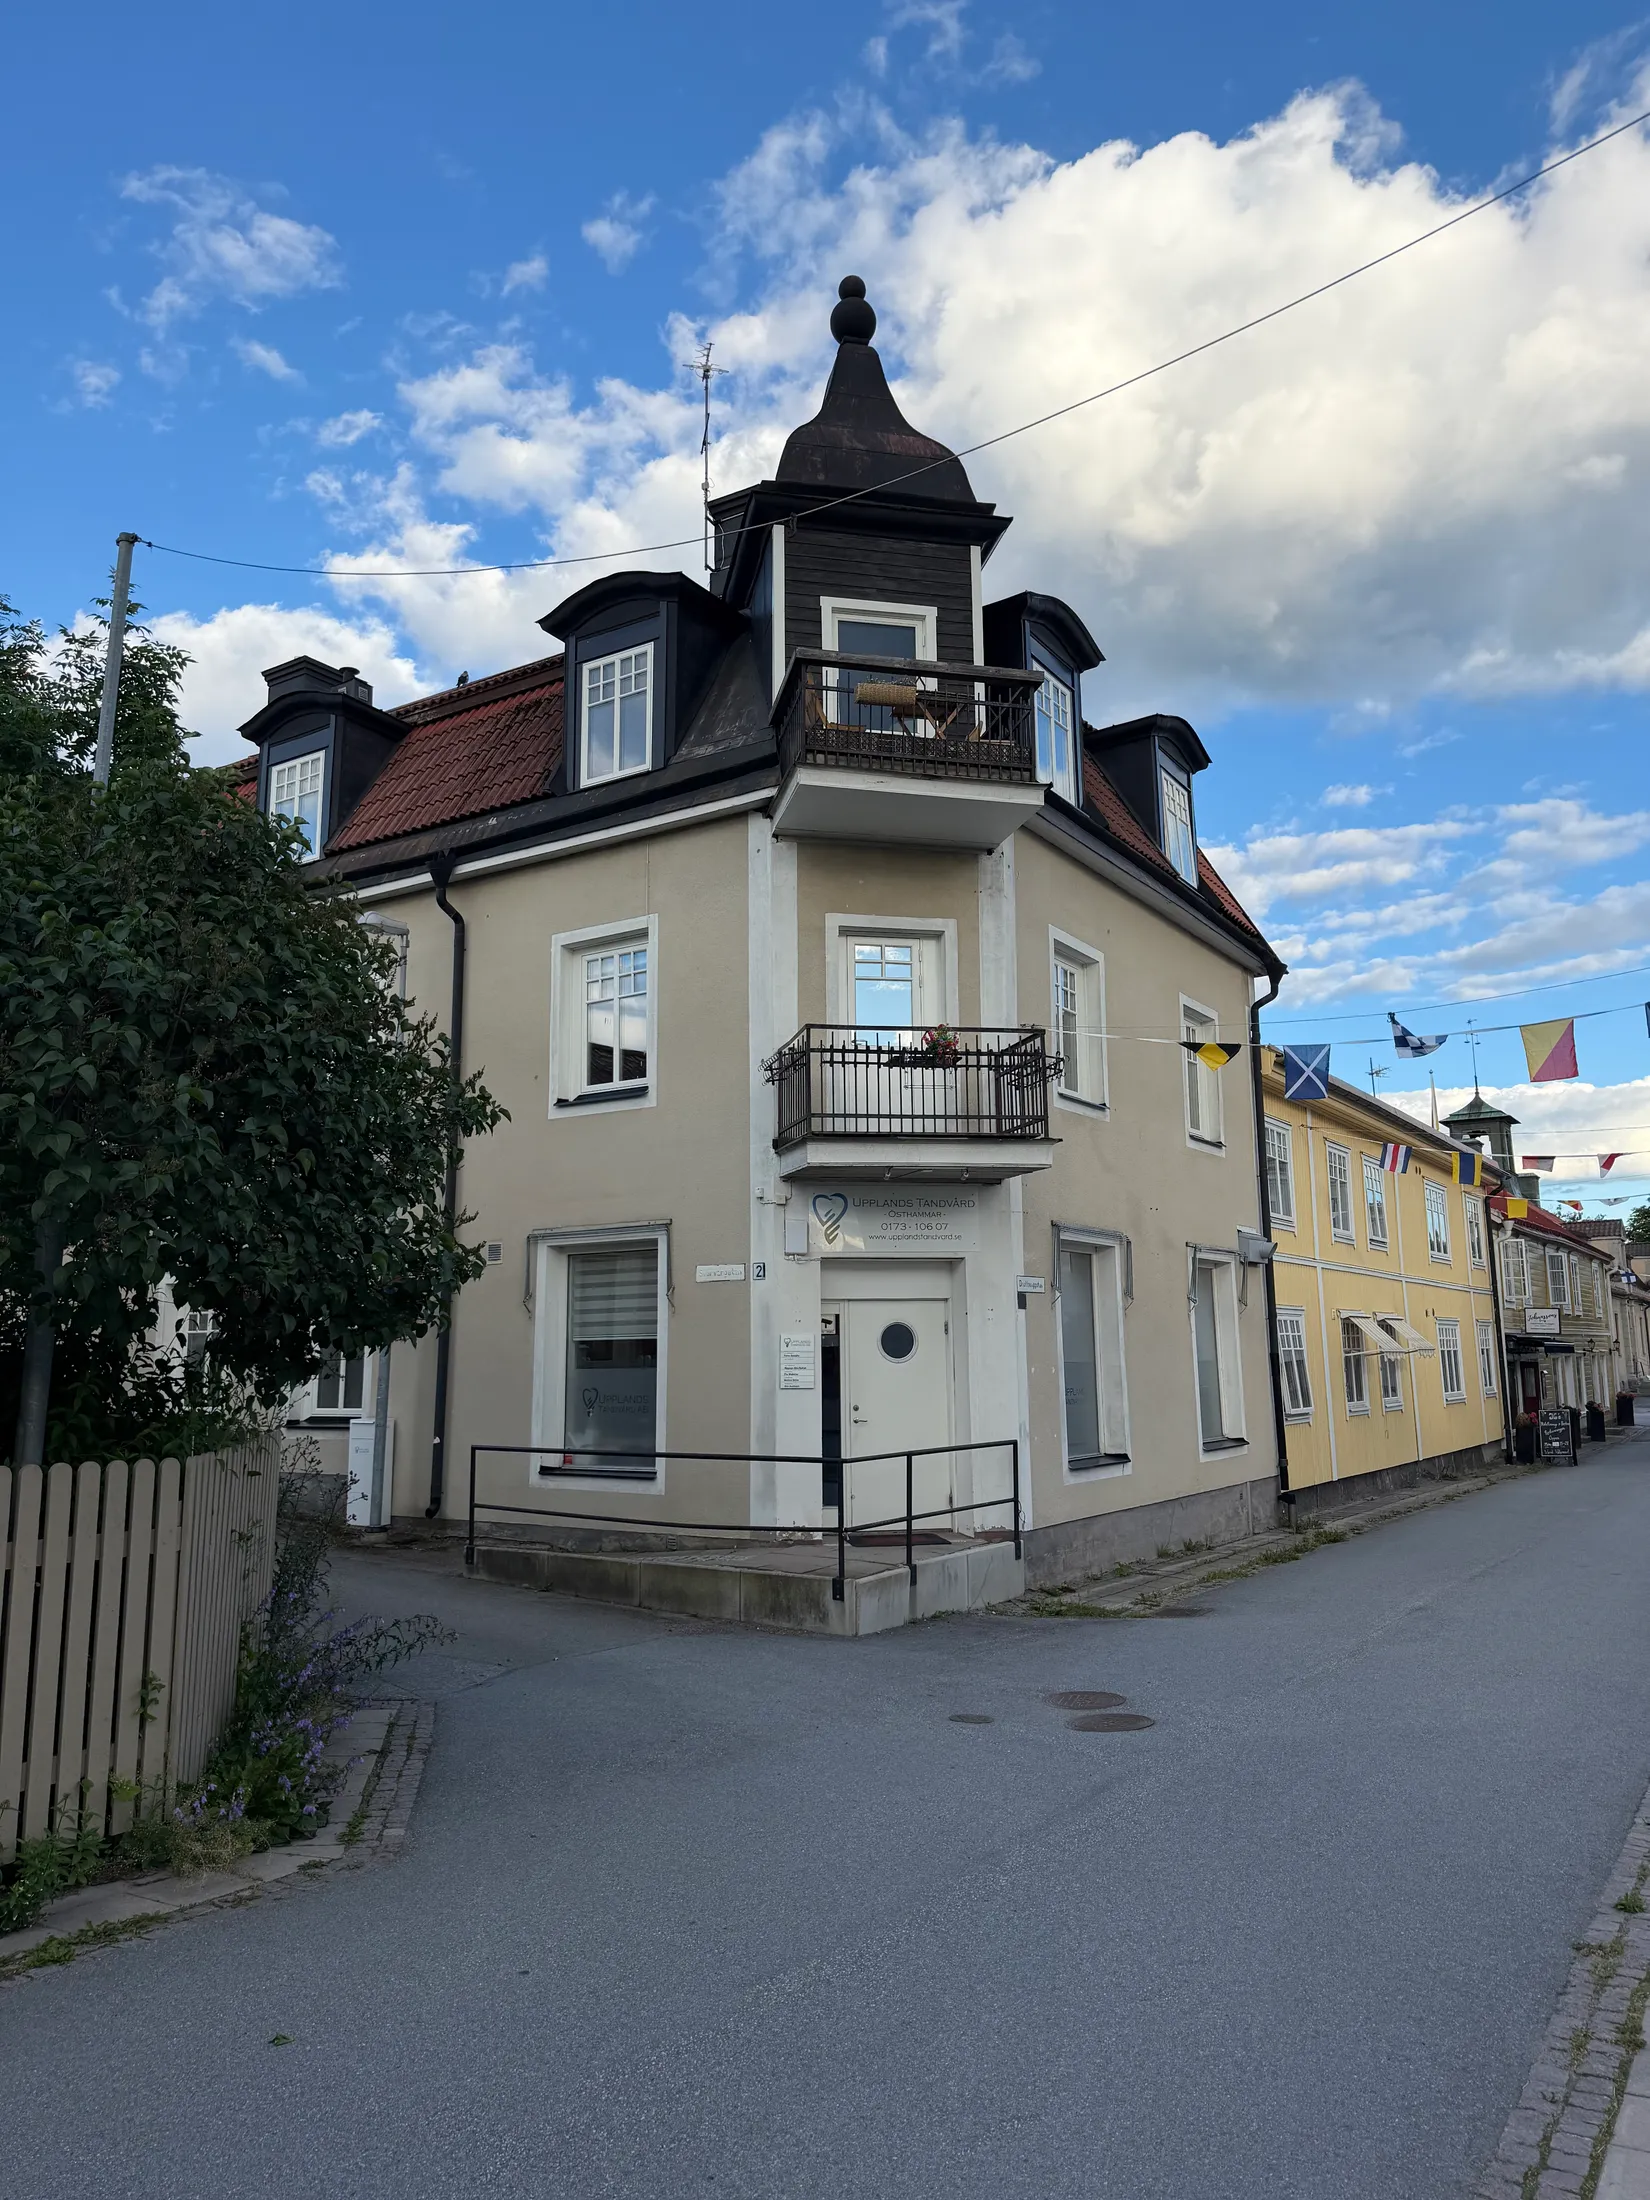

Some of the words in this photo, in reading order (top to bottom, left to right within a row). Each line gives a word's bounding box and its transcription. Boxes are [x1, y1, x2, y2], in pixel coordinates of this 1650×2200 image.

[852, 1197, 914, 1208] UPPLANDS
[916, 1197, 976, 1209] TANDVÅRD
[888, 1209, 942, 1218] ÖSTHAMMAR
[880, 1222, 907, 1231] 0173
[914, 1222, 934, 1231] 106
[935, 1222, 949, 1231] 07
[868, 1233, 962, 1241] www.upplandstandvard.se
[755, 1264, 763, 1278] 2
[598, 1394, 650, 1404] UPPLANDS
